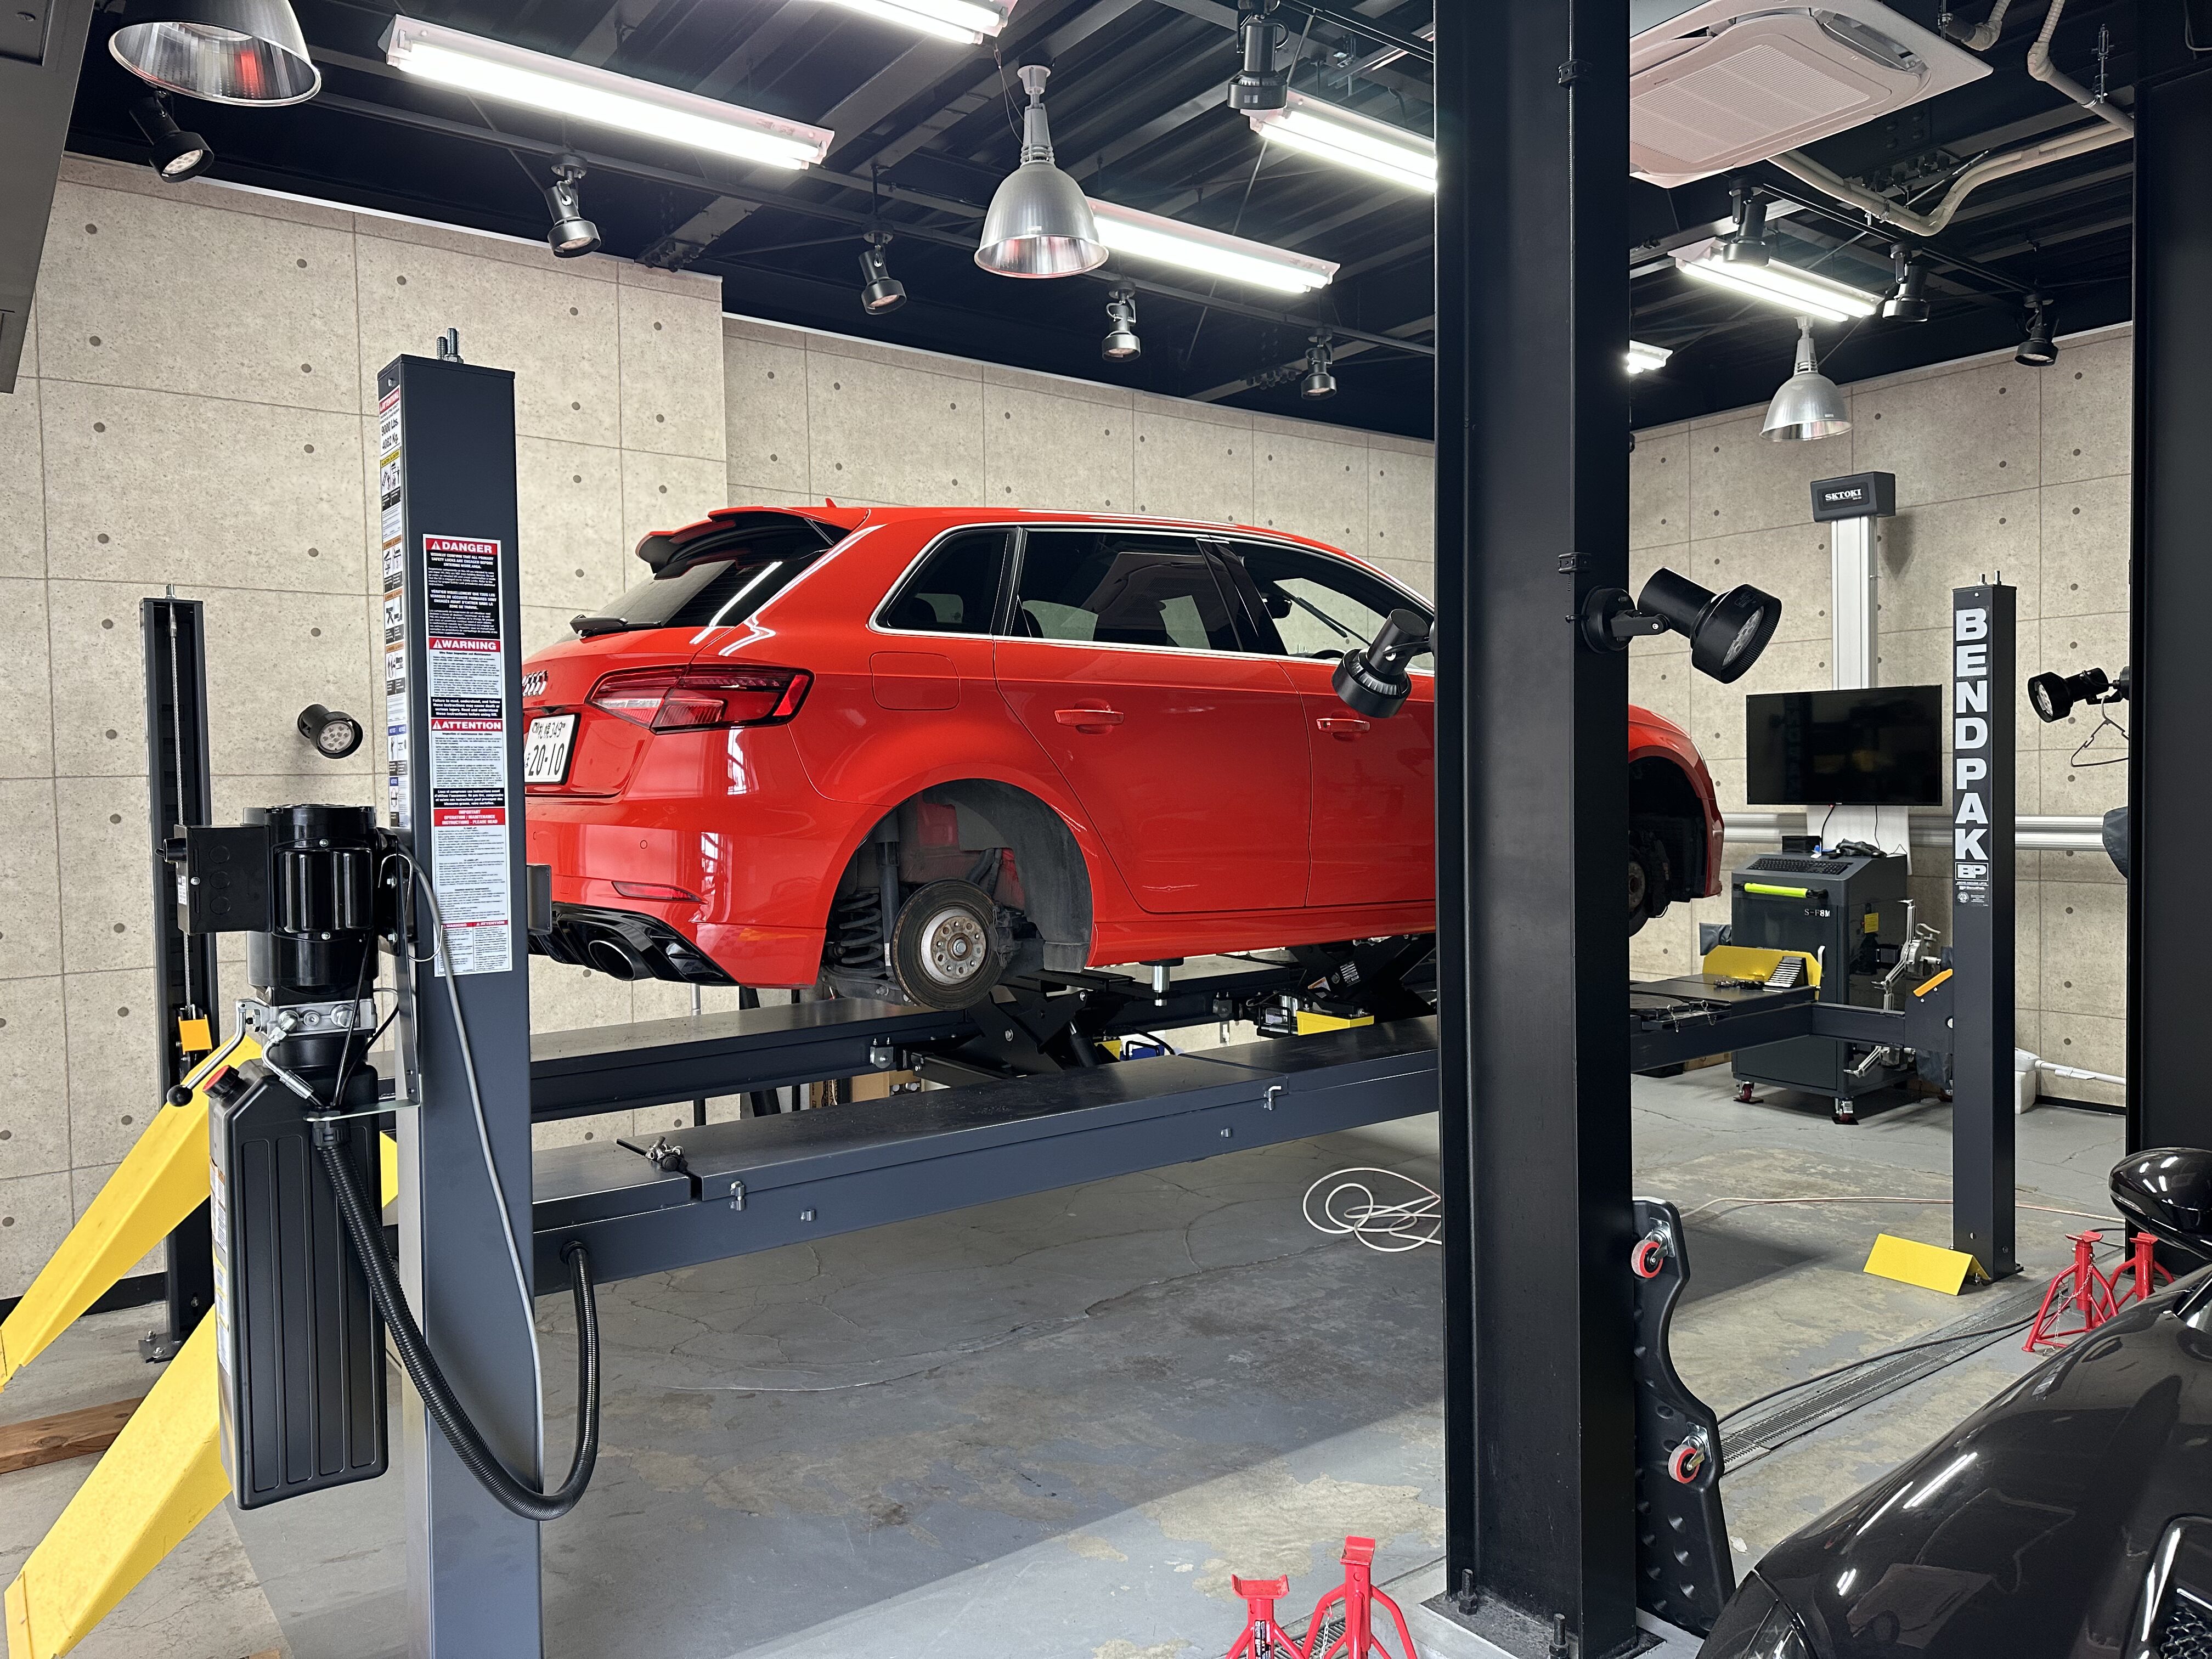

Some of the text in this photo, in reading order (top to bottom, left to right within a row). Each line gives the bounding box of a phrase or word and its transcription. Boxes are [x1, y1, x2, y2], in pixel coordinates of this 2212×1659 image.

[381, 421, 391, 437] 9000
[1825, 489, 1862, 501] SKTOKI
[442, 541, 492, 554] DANGER
[441, 640, 496, 650] WARNING
[442, 721, 501, 729] ATTENTION
[1955, 608, 1989, 860] BENDPAK
[528, 743, 564, 776] 20-10
[1957, 864, 1987, 879] BP
